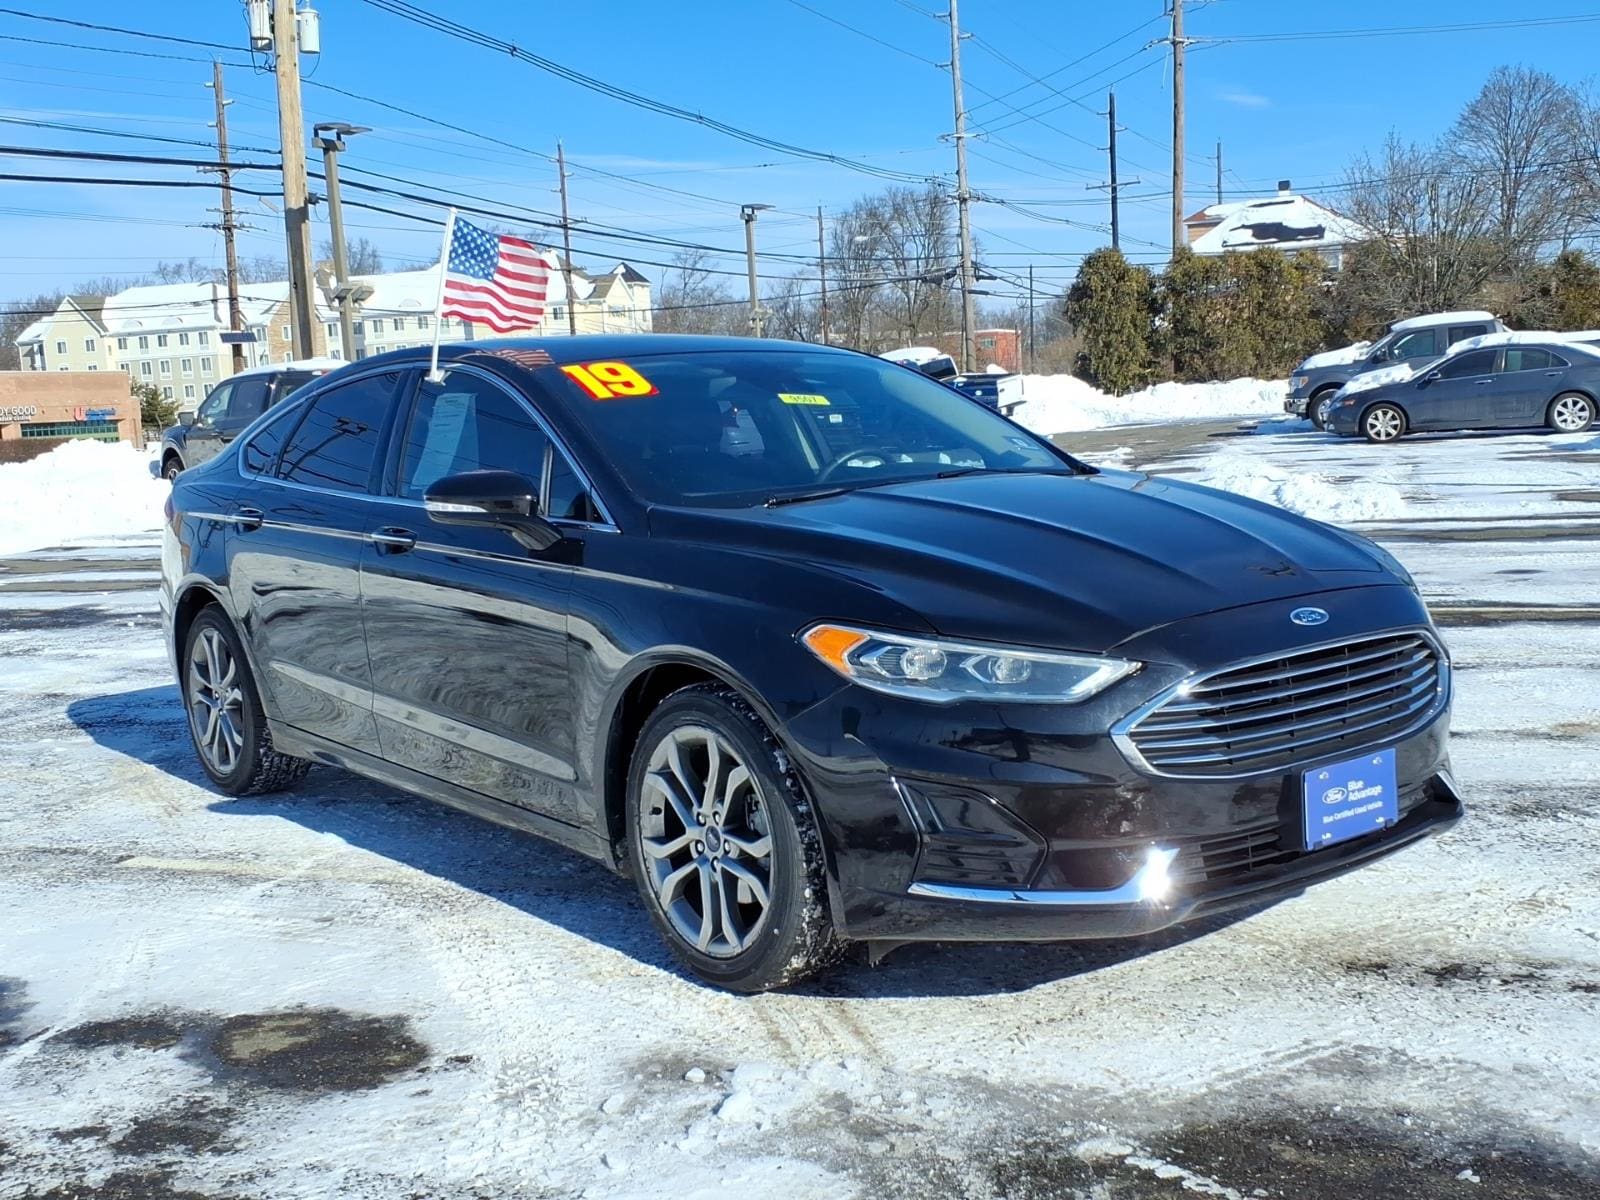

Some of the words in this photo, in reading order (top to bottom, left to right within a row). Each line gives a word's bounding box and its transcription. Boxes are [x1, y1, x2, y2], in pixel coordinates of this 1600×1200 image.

[560, 362, 654, 399] 19
[12, 405, 37, 416] GOOD
[1347, 780, 1364, 791] Blue
[1348, 785, 1382, 801] Advantage
[1334, 808, 1355, 820] Certified
[1354, 804, 1368, 814] Used
[1367, 800, 1383, 811] Vehicle
